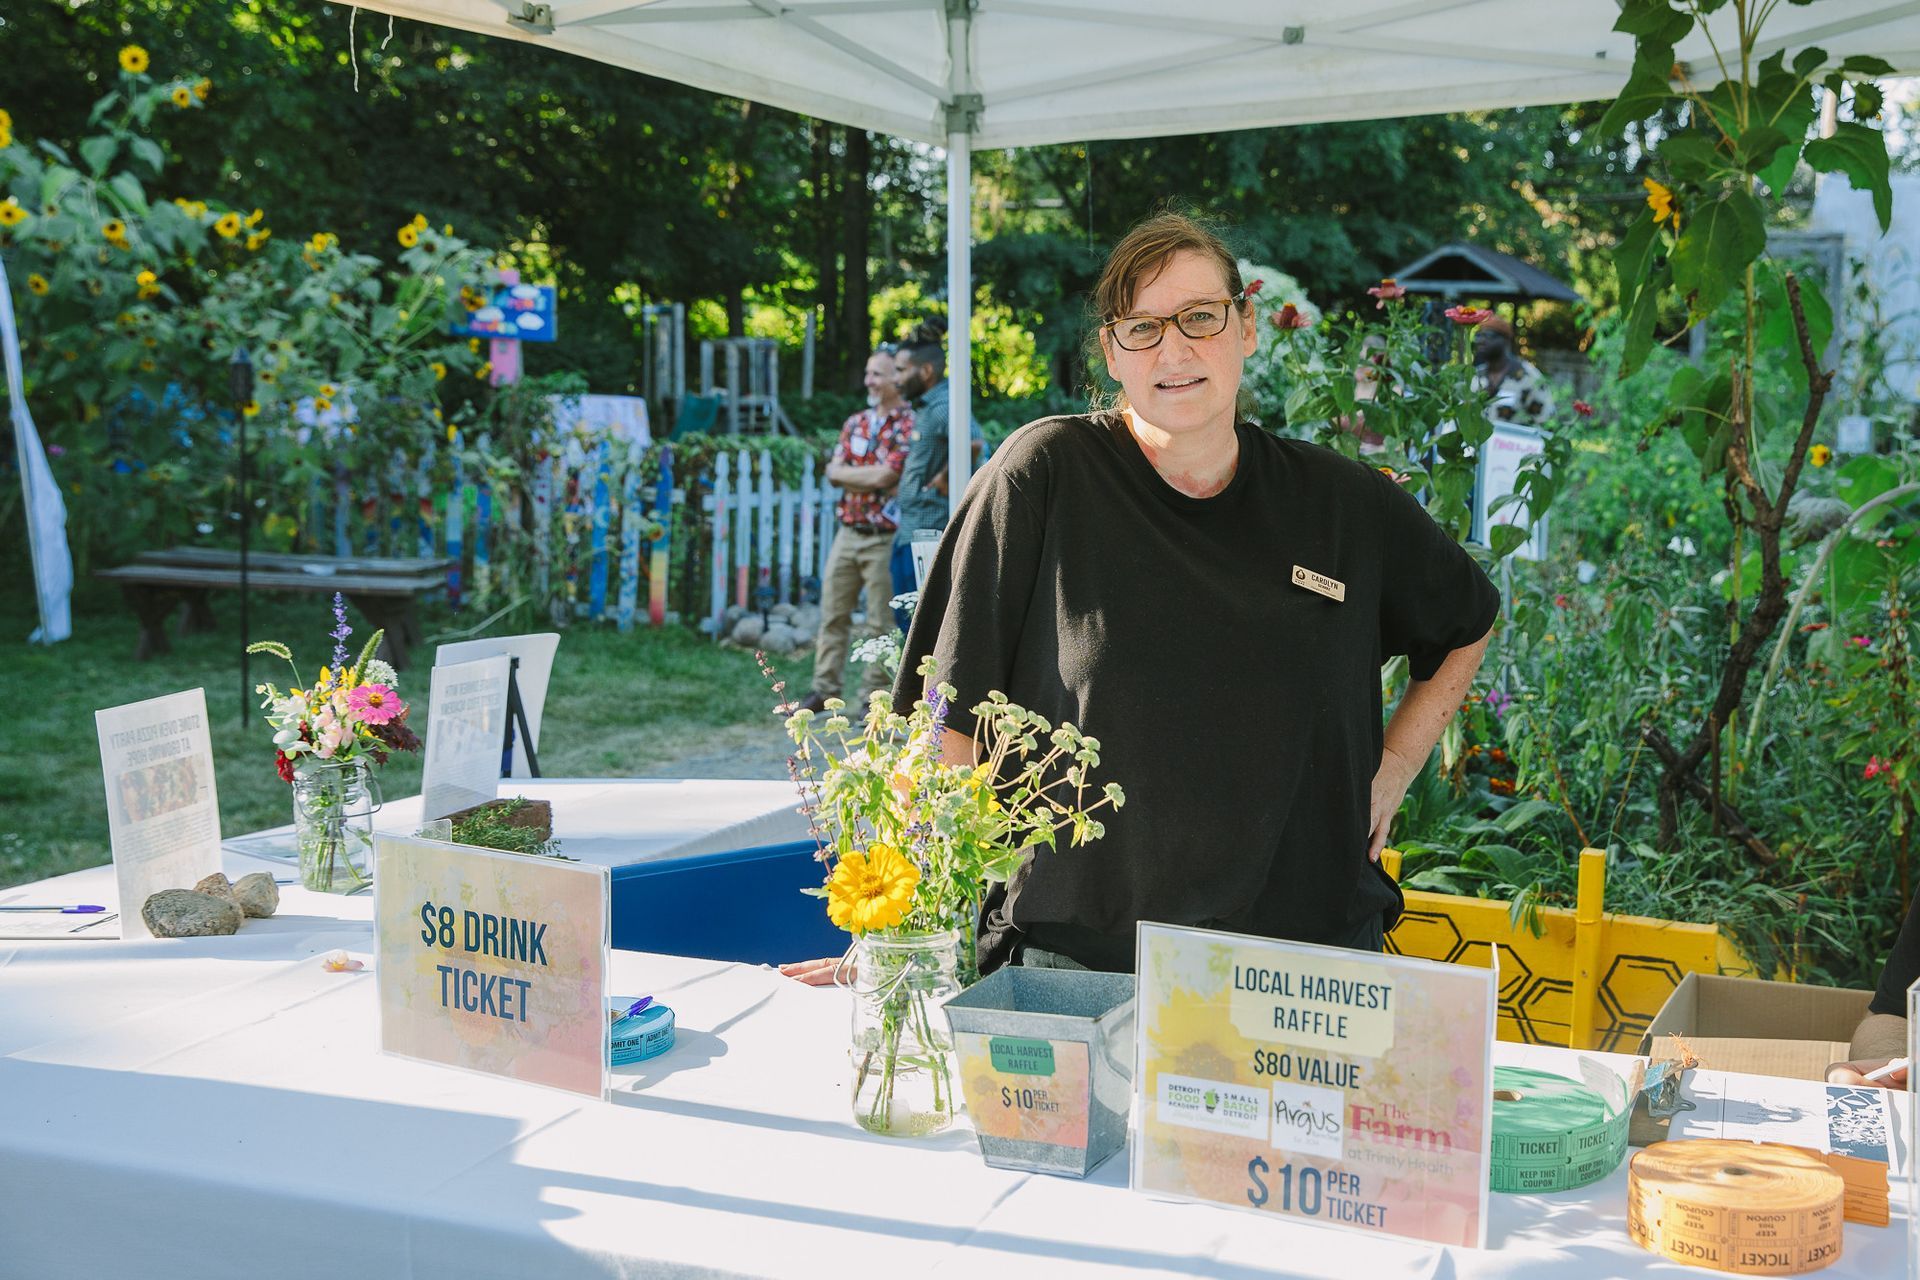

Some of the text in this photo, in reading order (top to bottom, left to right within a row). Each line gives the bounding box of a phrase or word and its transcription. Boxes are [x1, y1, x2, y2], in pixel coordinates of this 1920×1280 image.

[1311, 574, 1339, 590] CAROLYN
[421, 901, 548, 966] $8 DRINK
[436, 964, 532, 1022] TICKET
[1234, 965, 1392, 1011] LOCAL HARVEST
[1274, 1006, 1348, 1038] RAFFLE
[627, 1039, 640, 1047] ONE
[990, 1043, 1053, 1058] LOCAL HARVEST
[1007, 1059, 1039, 1071] RAFFLE
[1254, 1049, 1360, 1089] $80 VALUE
[1033, 1089, 1048, 1100] PER
[1168, 1084, 1200, 1095] DETROIT
[1001, 1086, 1034, 1109] $10
[1168, 1092, 1200, 1104] FOOD
[1224, 1093, 1259, 1105] SMALL
[1034, 1101, 1059, 1112] TICKET
[1223, 1100, 1258, 1113] BATCH
[1379, 1101, 1411, 1121] The
[1223, 1109, 1258, 1121] DETROIT
[1275, 1099, 1340, 1135] Argus
[1349, 1103, 1452, 1154] Farm
[1579, 1131, 1607, 1149] TICKET
[1520, 1142, 1558, 1155] TICKET
[1347, 1148, 1454, 1176] at Trinity Health
[1520, 1169, 1556, 1179] KEEP THIS
[1247, 1155, 1322, 1216] $10
[1327, 1170, 1361, 1196] PER
[1522, 1179, 1553, 1188] COUPON
[1326, 1196, 1388, 1228] TICKET
[1676, 1202, 1714, 1216] COUPON
[1746, 1213, 1786, 1222] COUPON
[1755, 1229, 1777, 1237] KEEP
[1670, 1238, 1719, 1261] TICKET
[1807, 1242, 1838, 1263] TICKET
[1739, 1251, 1791, 1266] TICKET
